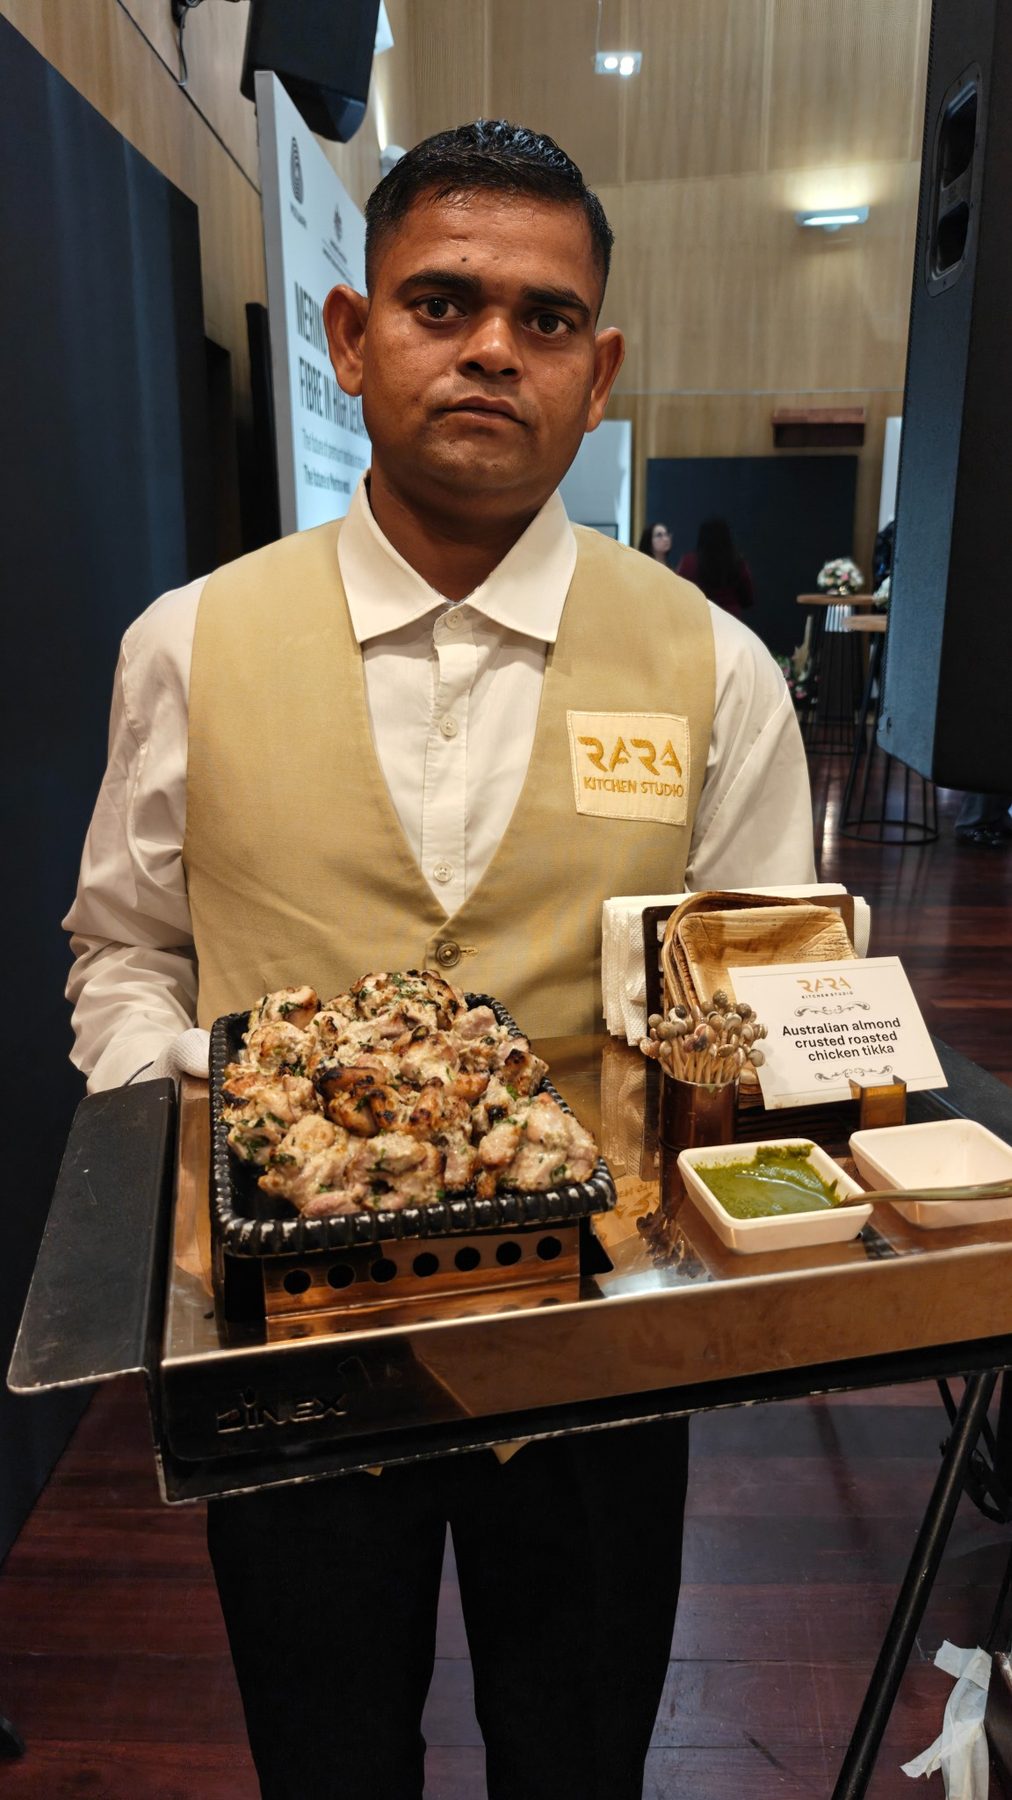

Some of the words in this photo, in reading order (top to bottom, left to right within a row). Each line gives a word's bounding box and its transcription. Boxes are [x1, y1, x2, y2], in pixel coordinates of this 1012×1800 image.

[299, 356, 322, 417] FIBRE
[578, 736, 682, 778] RARA
[584, 776, 637, 794] KITCHEN
[640, 781, 684, 798] STUDIO
[797, 976, 851, 992] RARA
[782, 1021, 849, 1037] Australian
[852, 1017, 901, 1032] almond
[795, 1035, 845, 1049] crusted
[848, 1031, 898, 1045] roasted
[808, 1047, 860, 1062] chicken
[862, 1043, 895, 1056] tikka
